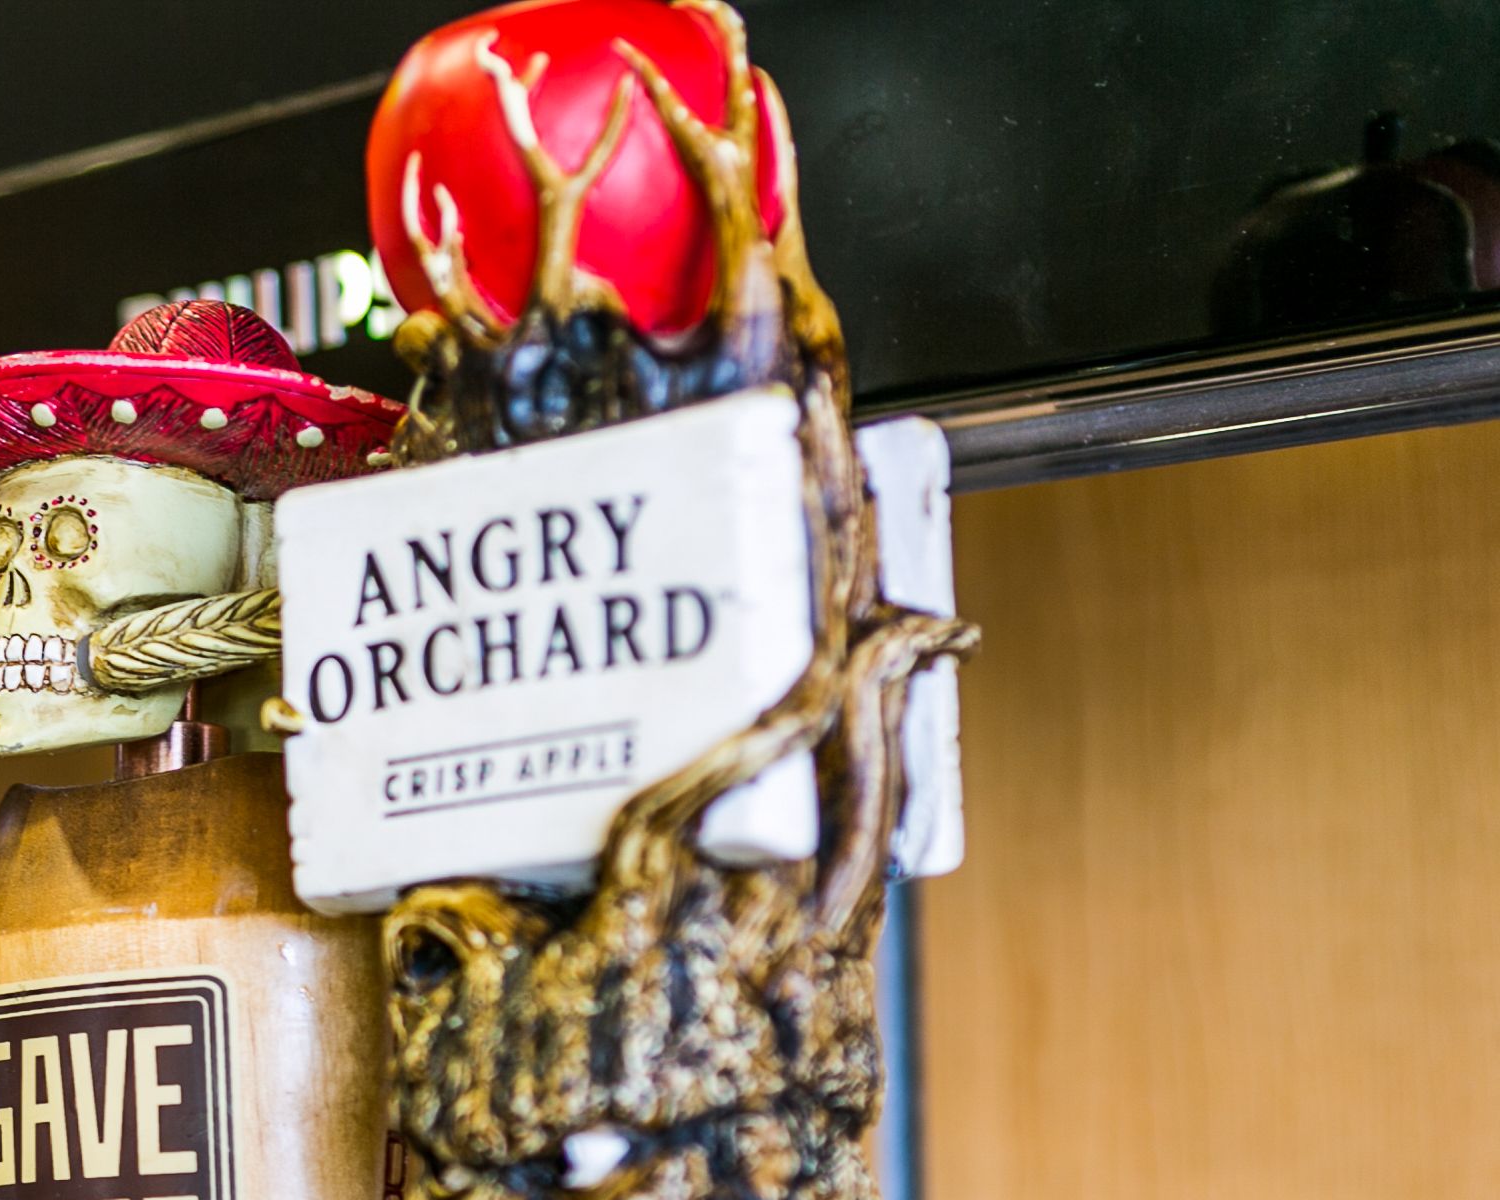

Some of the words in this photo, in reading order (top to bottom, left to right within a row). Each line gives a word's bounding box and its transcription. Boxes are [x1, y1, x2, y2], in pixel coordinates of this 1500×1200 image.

[352, 493, 650, 628] ANGRY
[308, 586, 714, 724] ORCHARD
[384, 757, 494, 802] CRISP
[517, 735, 635, 782] APPLE
